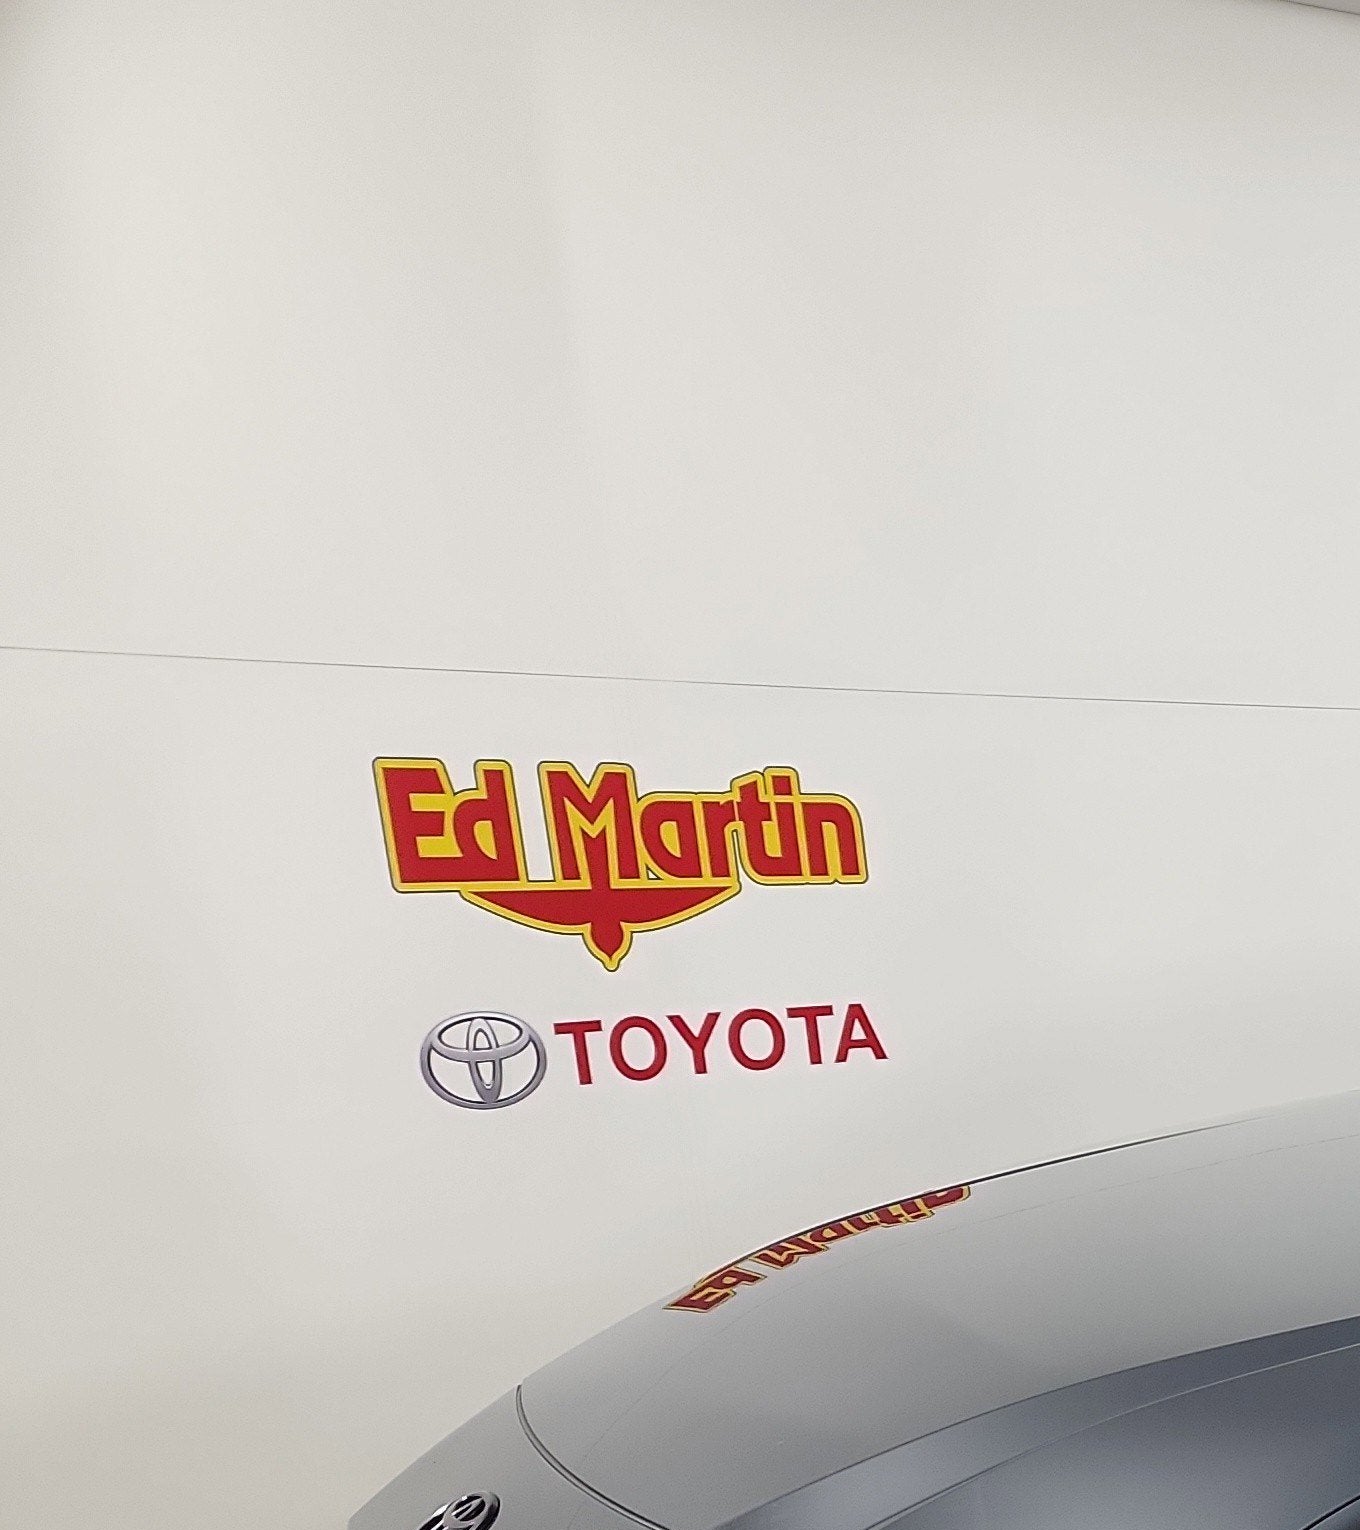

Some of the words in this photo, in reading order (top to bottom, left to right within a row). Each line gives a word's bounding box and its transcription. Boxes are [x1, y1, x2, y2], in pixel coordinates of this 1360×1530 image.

[373, 757, 526, 892] Ed
[538, 761, 869, 888] Martin
[554, 1003, 889, 1086] TOYOTA
